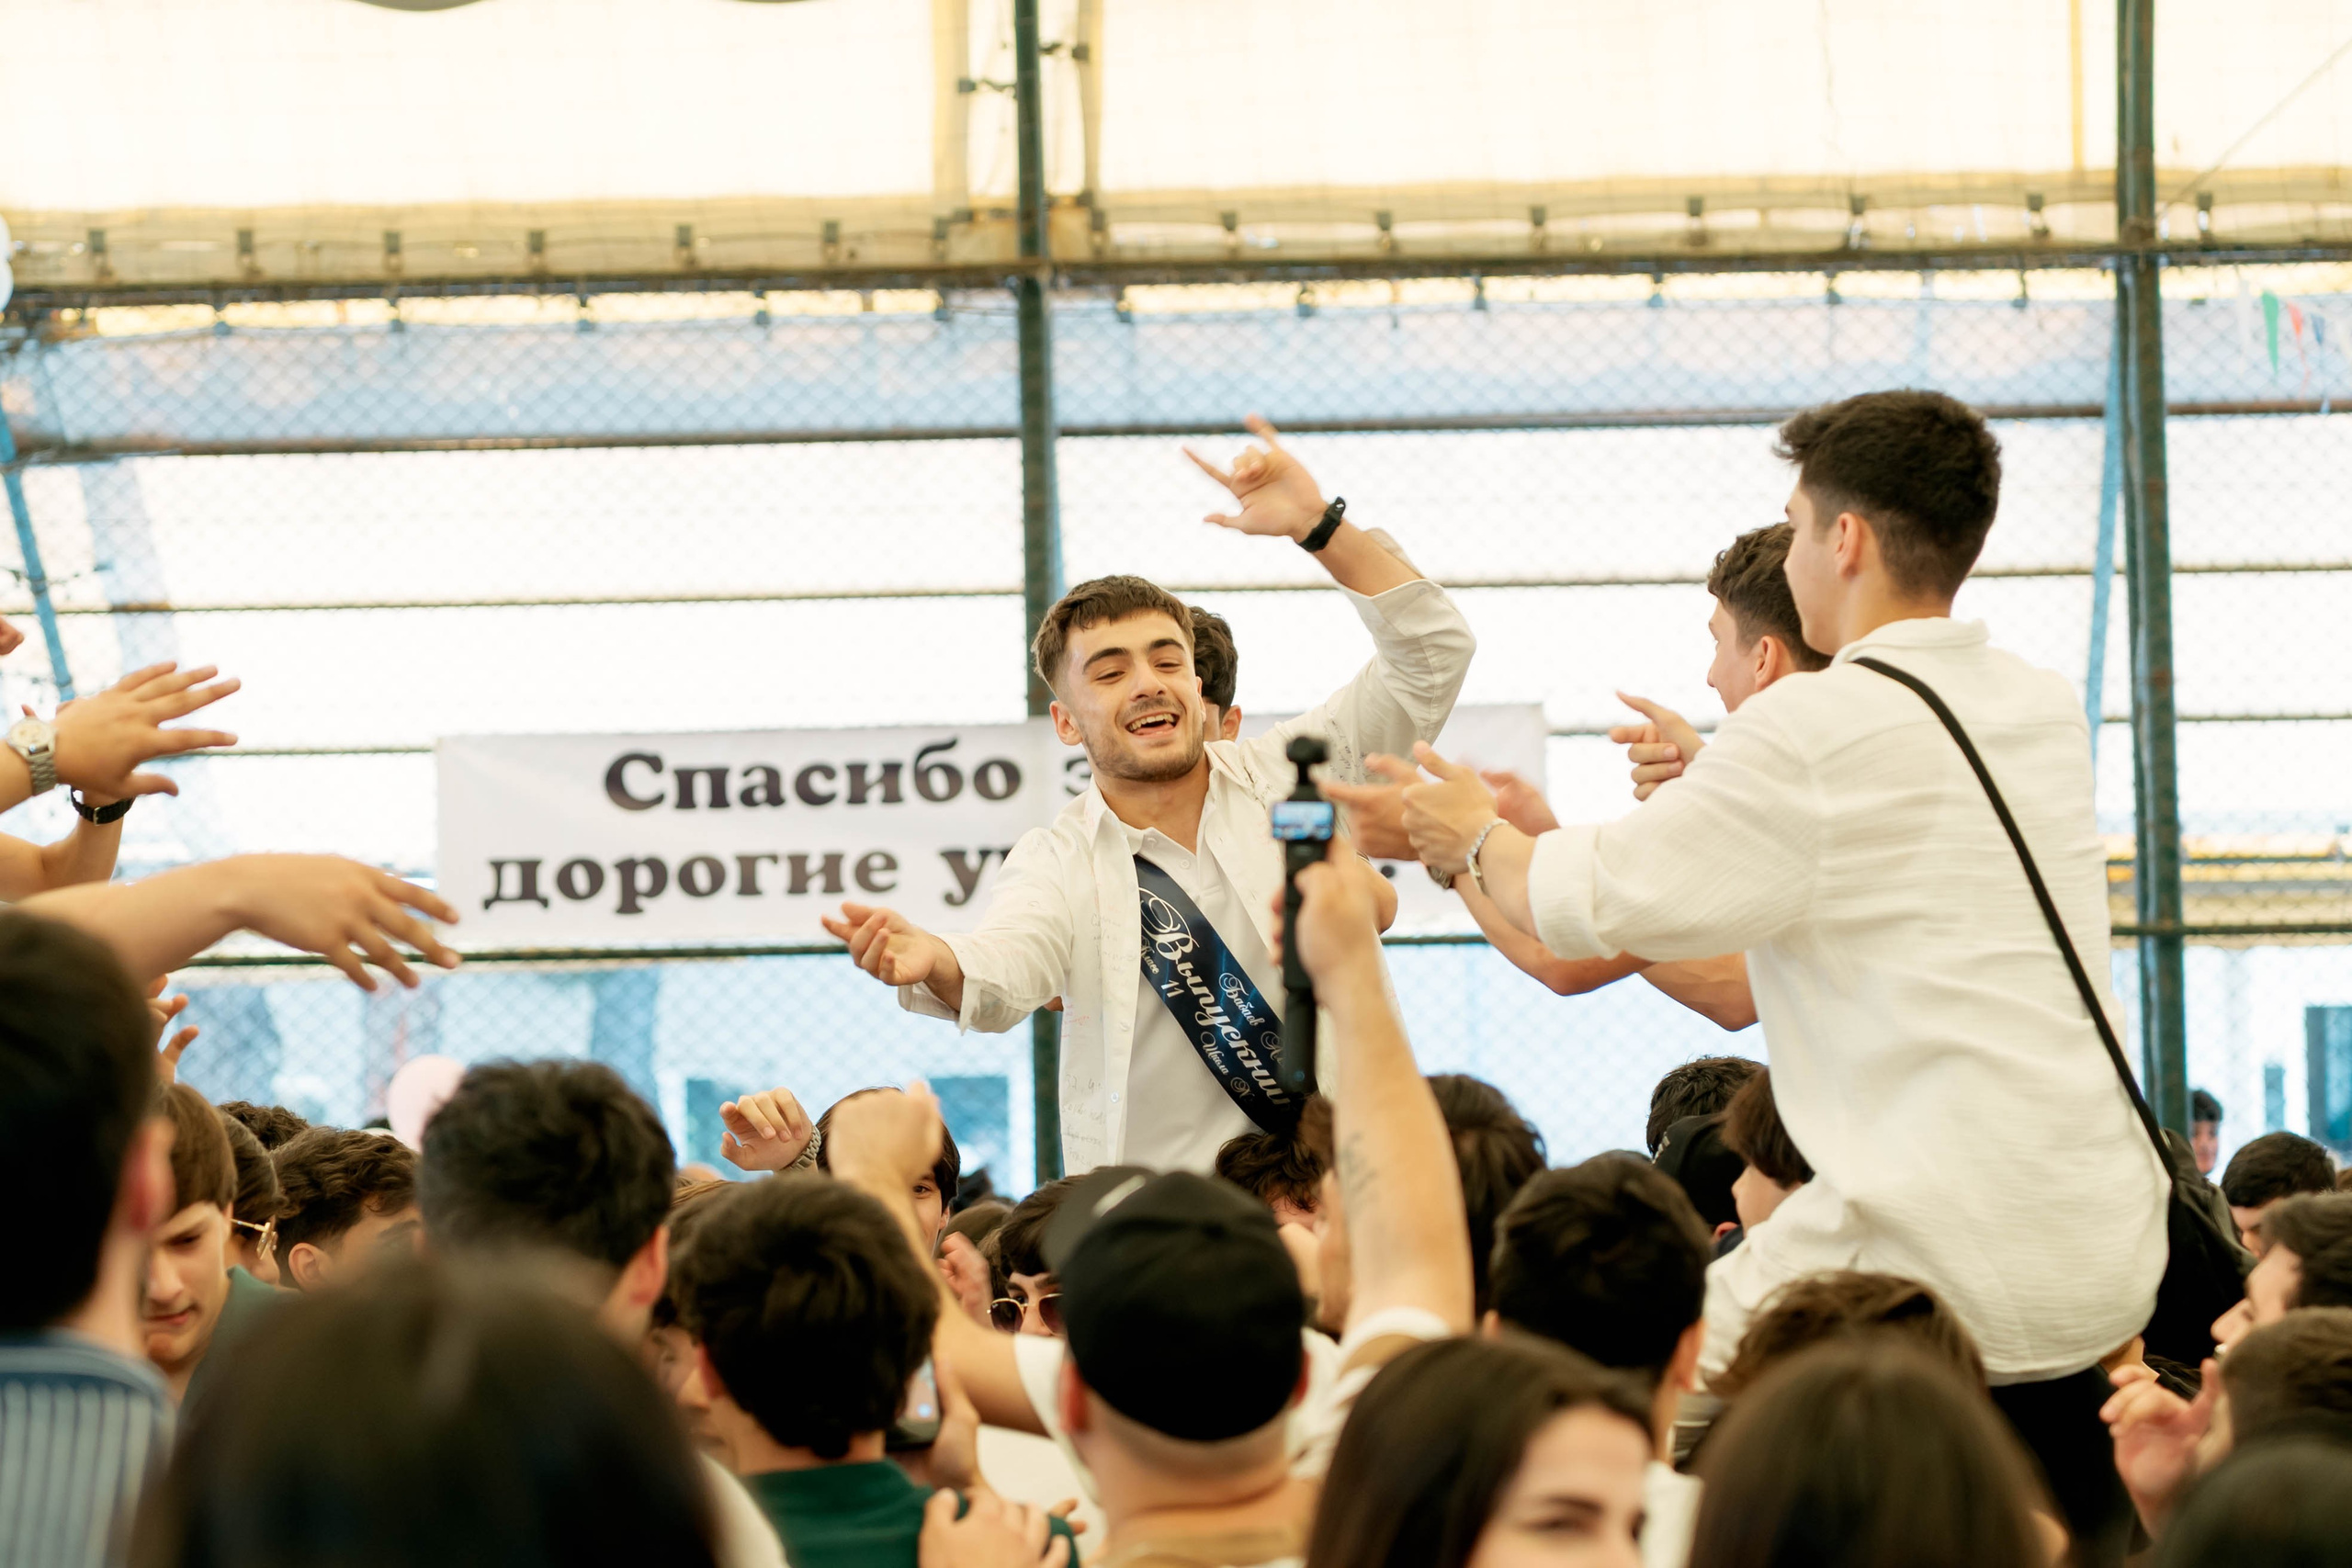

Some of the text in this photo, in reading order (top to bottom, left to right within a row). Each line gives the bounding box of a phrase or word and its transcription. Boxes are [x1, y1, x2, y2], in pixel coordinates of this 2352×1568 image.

[604, 736, 1023, 811] Спасибо
[483, 849, 899, 915] дорогие
[1160, 979, 1185, 998] 11
[1218, 972, 1266, 1026] Бабаев
[1200, 1032, 1229, 1076] Школа
